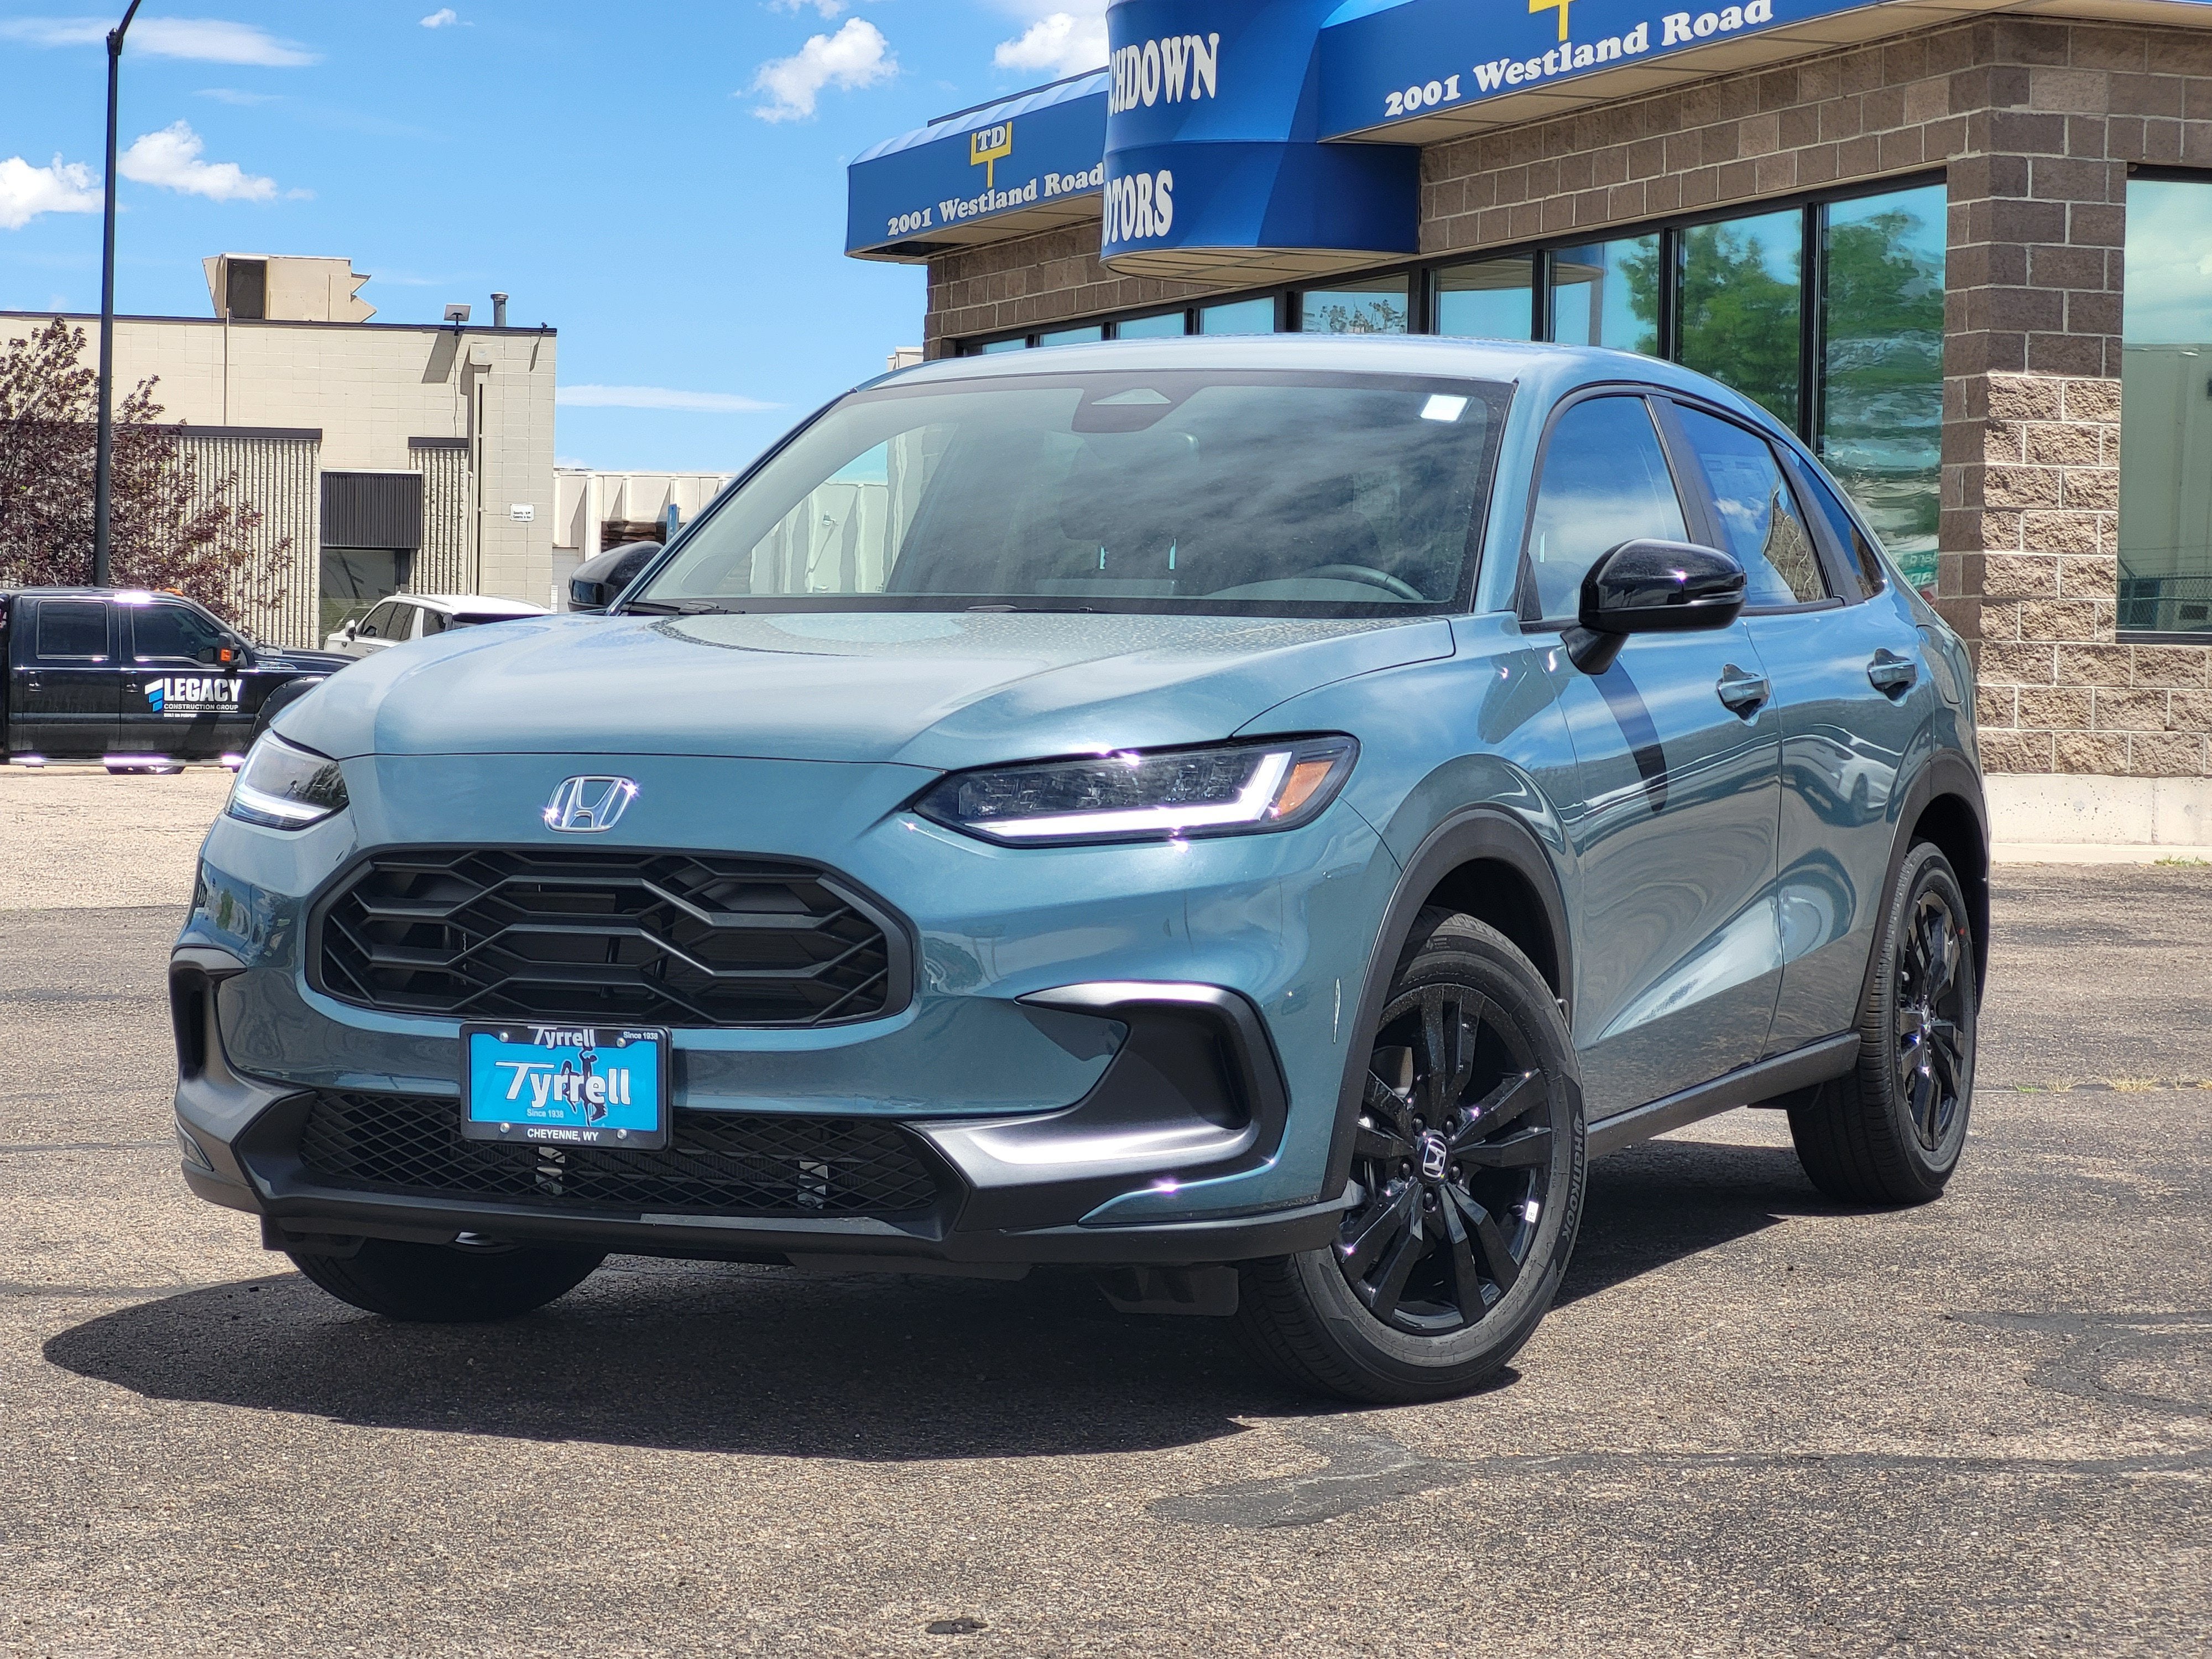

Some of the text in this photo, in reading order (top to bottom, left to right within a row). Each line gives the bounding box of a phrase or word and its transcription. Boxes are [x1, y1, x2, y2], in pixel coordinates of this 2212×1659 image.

[1384, 0, 1773, 117] 2001 Westland Road
[977, 126, 1006, 151] TD
[887, 162, 1104, 236] 2001 Westland Road
[164, 678, 242, 702] LEGACY
[527, 1026, 596, 1049] Tyrrell
[623, 1031, 641, 1040] Since
[495, 1062, 631, 1108] Tyrrell
[526, 1109, 564, 1118] Since 1938
[527, 1129, 599, 1141] CHEYENNE, WY
[1562, 1136, 1583, 1242] Hankook
